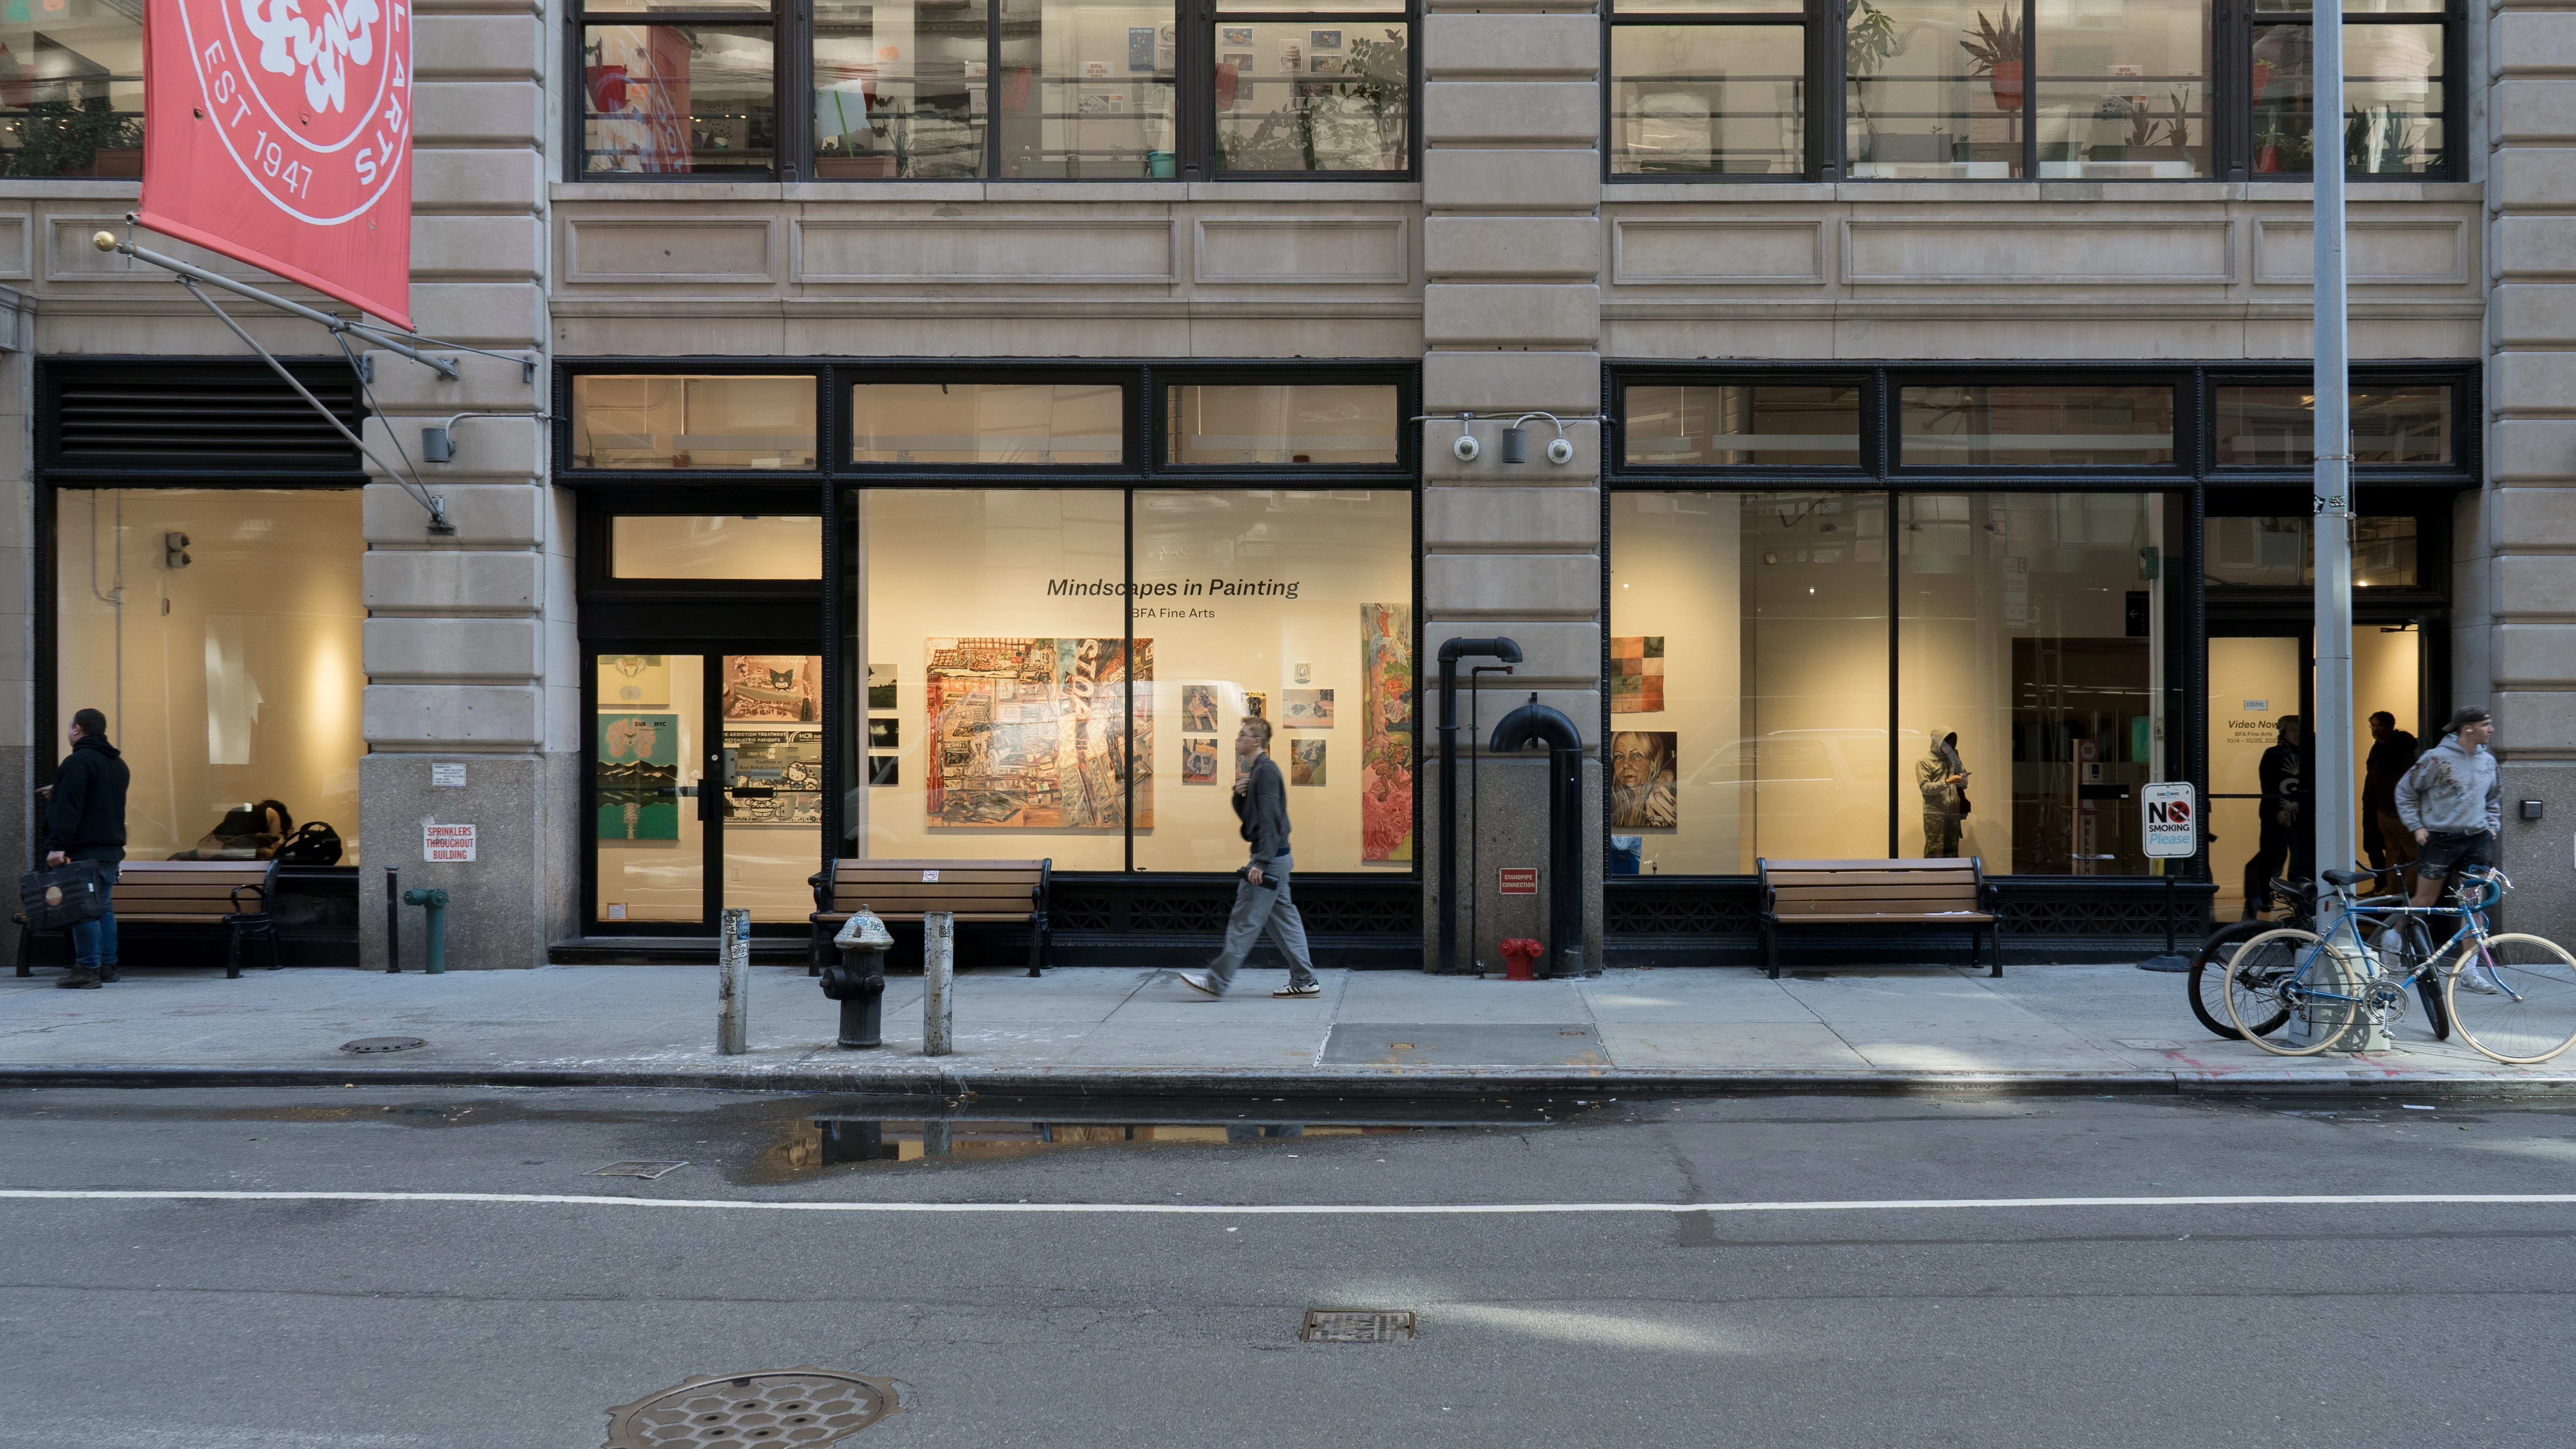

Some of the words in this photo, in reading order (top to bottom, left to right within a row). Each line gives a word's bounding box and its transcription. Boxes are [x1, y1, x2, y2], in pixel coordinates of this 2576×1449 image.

[205, 39, 252, 128] EST
[253, 130, 312, 199] 1947
[355, 51, 404, 185] ARTS
[1184, 579, 1203, 596] in
[1209, 579, 1300, 599] Painting
[1132, 608, 1156, 618] BFA
[1160, 608, 1186, 618] Fine
[1189, 608, 1215, 618] Arts
[2149, 801, 2190, 823] NO
[427, 827, 472, 837] SPRINKLERS
[2149, 824, 2190, 832] SMOKING
[426, 838, 474, 848] THROUGHOUT
[2150, 833, 2190, 844] Please
[433, 850, 467, 859] BUILDING
